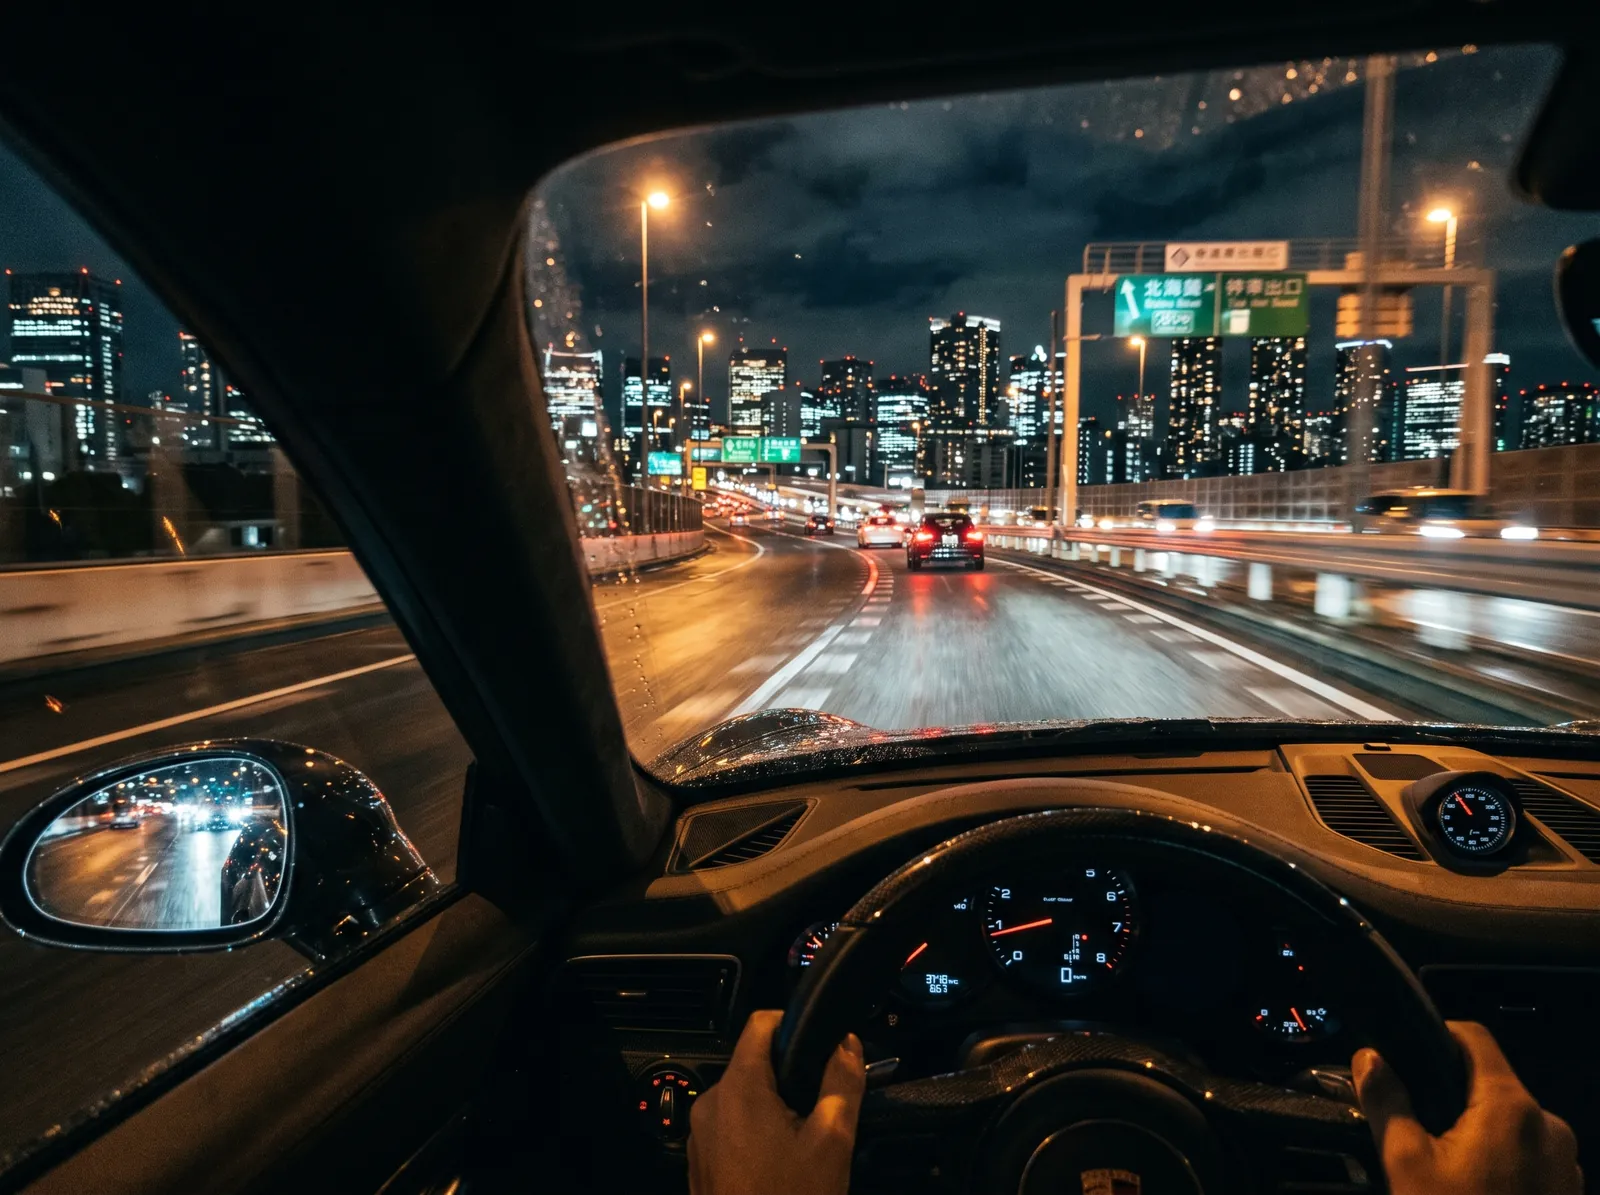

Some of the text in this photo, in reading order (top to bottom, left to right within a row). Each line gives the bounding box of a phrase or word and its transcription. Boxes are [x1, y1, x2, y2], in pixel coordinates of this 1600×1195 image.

[1085, 869, 1096, 878] 5
[1001, 889, 1011, 899] 2
[1106, 891, 1116, 901] 6
[996, 919, 1003, 930] 1
[1112, 922, 1122, 933] 7
[1013, 951, 1023, 961] 0
[1096, 953, 1106, 963] 8
